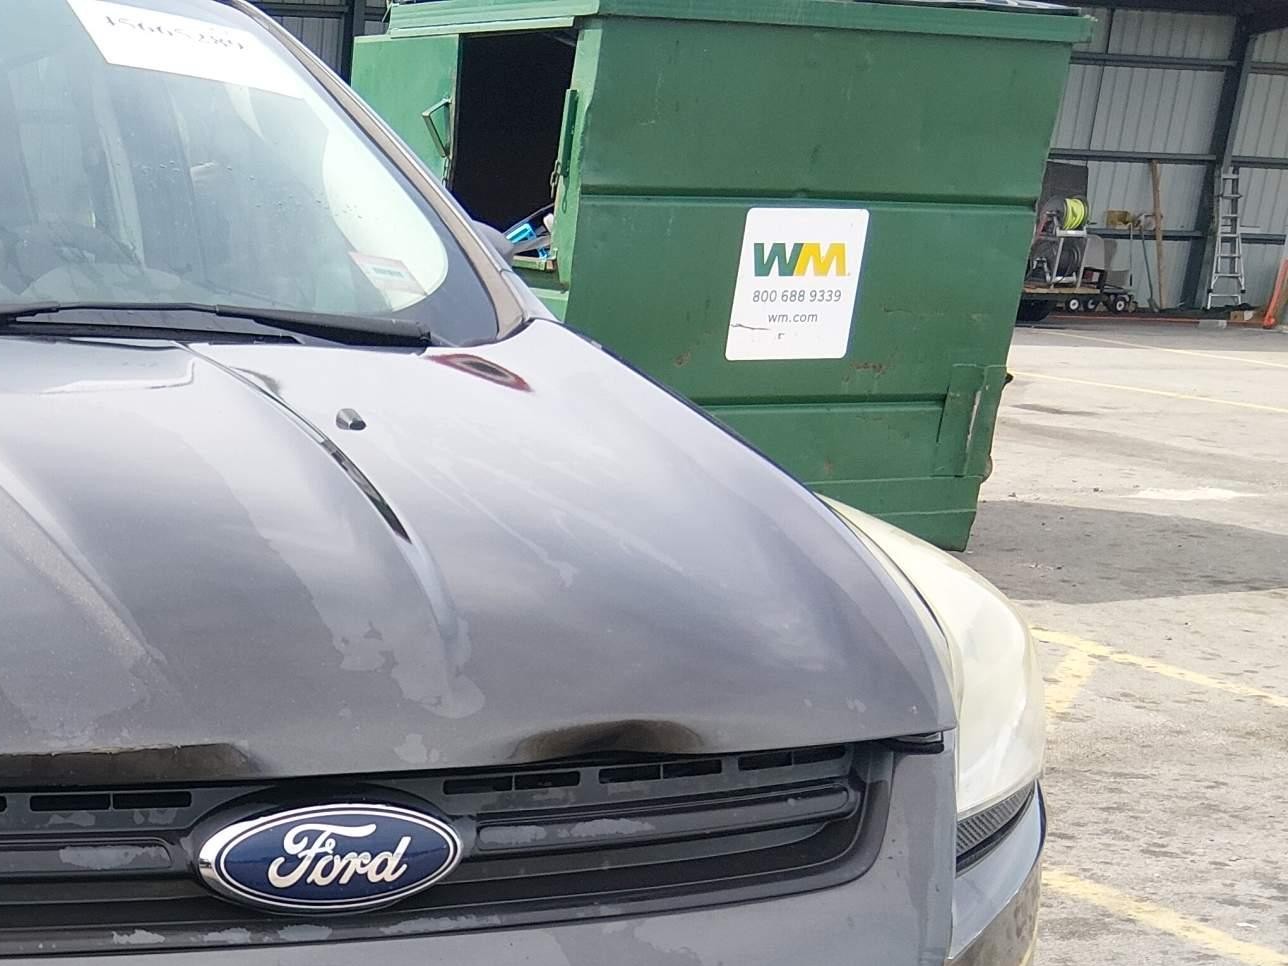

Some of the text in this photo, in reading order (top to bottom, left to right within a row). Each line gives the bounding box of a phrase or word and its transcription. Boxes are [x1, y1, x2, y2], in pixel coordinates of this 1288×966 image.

[754, 243, 846, 277] WM
[753, 290, 841, 302] 800 688 9339
[768, 313, 818, 323] wm.com
[268, 823, 411, 888] Ford
